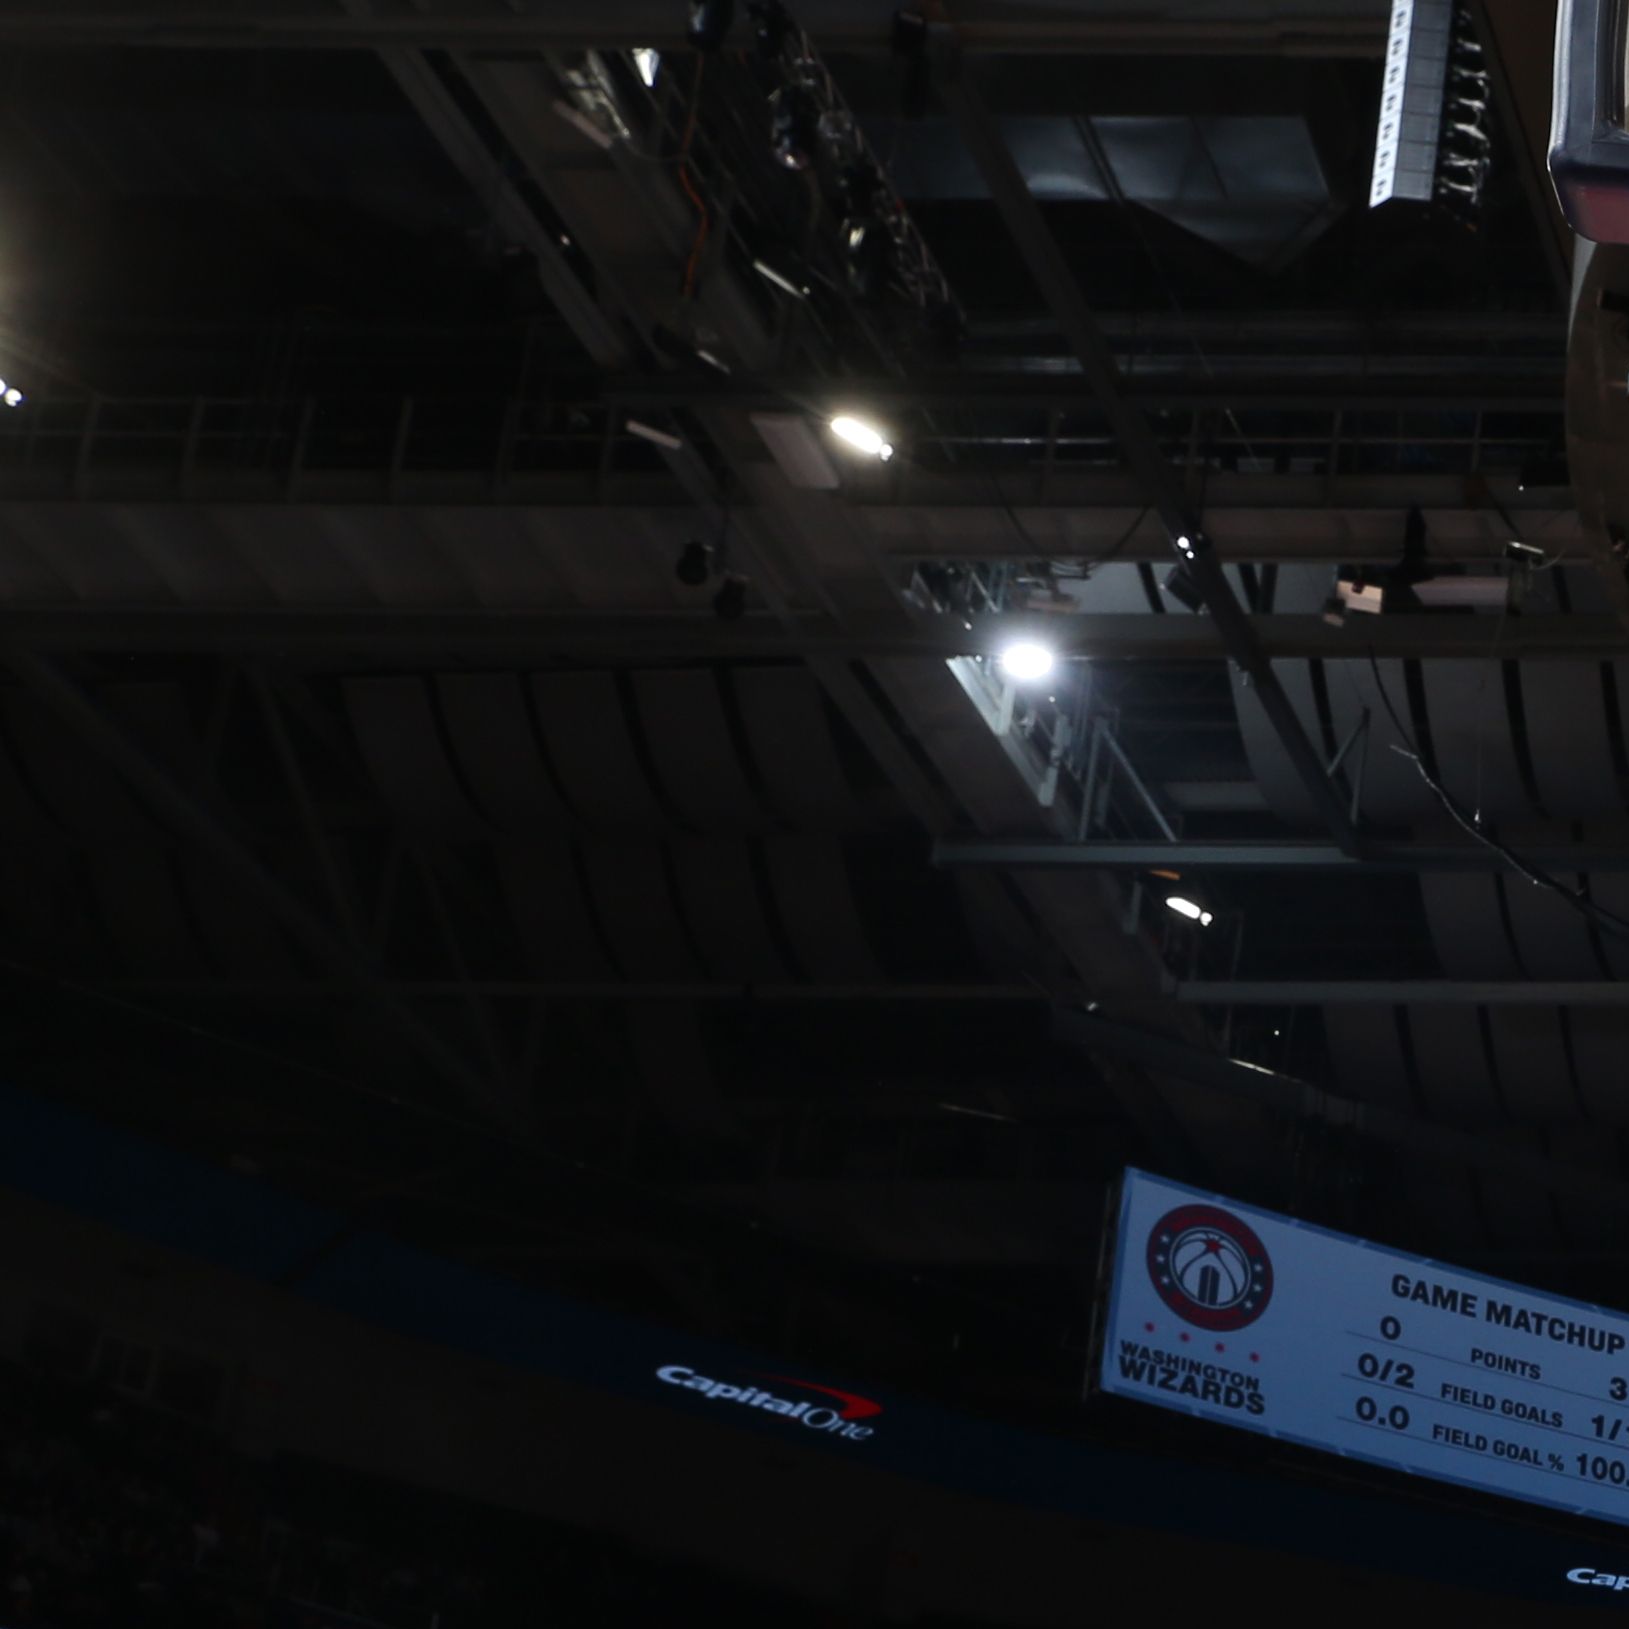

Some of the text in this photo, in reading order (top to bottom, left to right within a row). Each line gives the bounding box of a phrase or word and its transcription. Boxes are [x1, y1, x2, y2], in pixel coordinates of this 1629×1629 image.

[1380, 1315, 1402, 1340] 0
[1391, 1273, 1626, 1355] GAME MATCHUP
[1120, 1340, 1260, 1391] WASHINGTON
[1357, 1353, 1415, 1389] 0/2
[1470, 1348, 1541, 1380] POINTS
[1118, 1355, 1265, 1415] WIZARDS
[1608, 1377, 1628, 1401] 3
[1355, 1396, 1410, 1430] 0.0
[1440, 1383, 1563, 1428] FIELD GOALS
[1432, 1424, 1565, 1472] FIELD GOAL %
